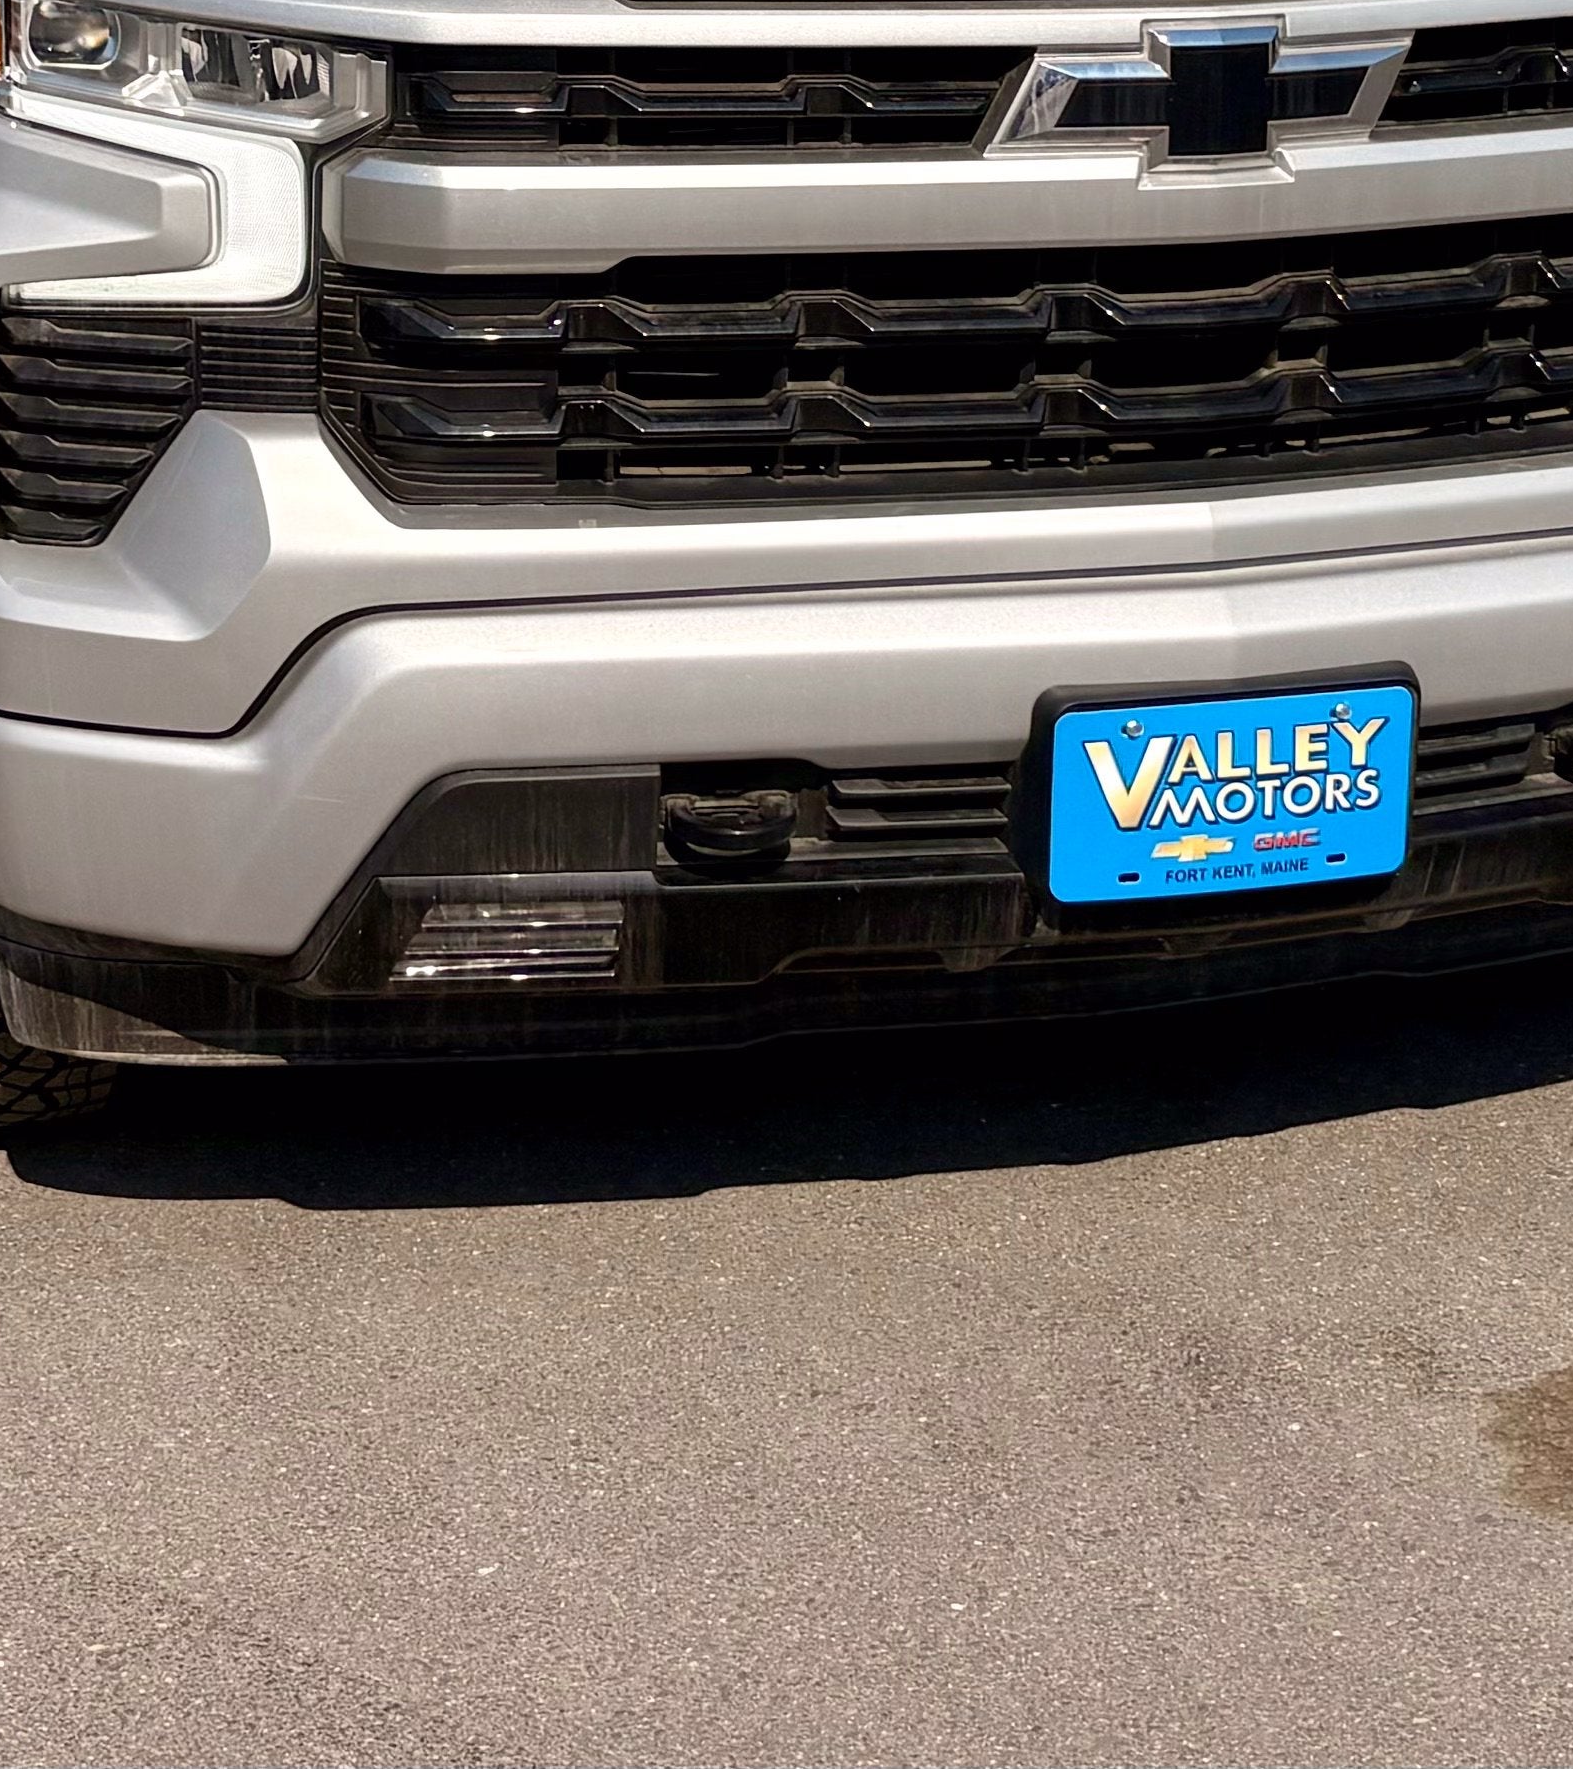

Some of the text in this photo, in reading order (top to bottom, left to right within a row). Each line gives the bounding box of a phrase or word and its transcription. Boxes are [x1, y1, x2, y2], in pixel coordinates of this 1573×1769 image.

[1082, 716, 1390, 830] VALLEY
[1148, 768, 1381, 830] MOTORS
[1254, 827, 1322, 851] GMC
[1165, 858, 1309, 883] FORT KENT, MAINE
